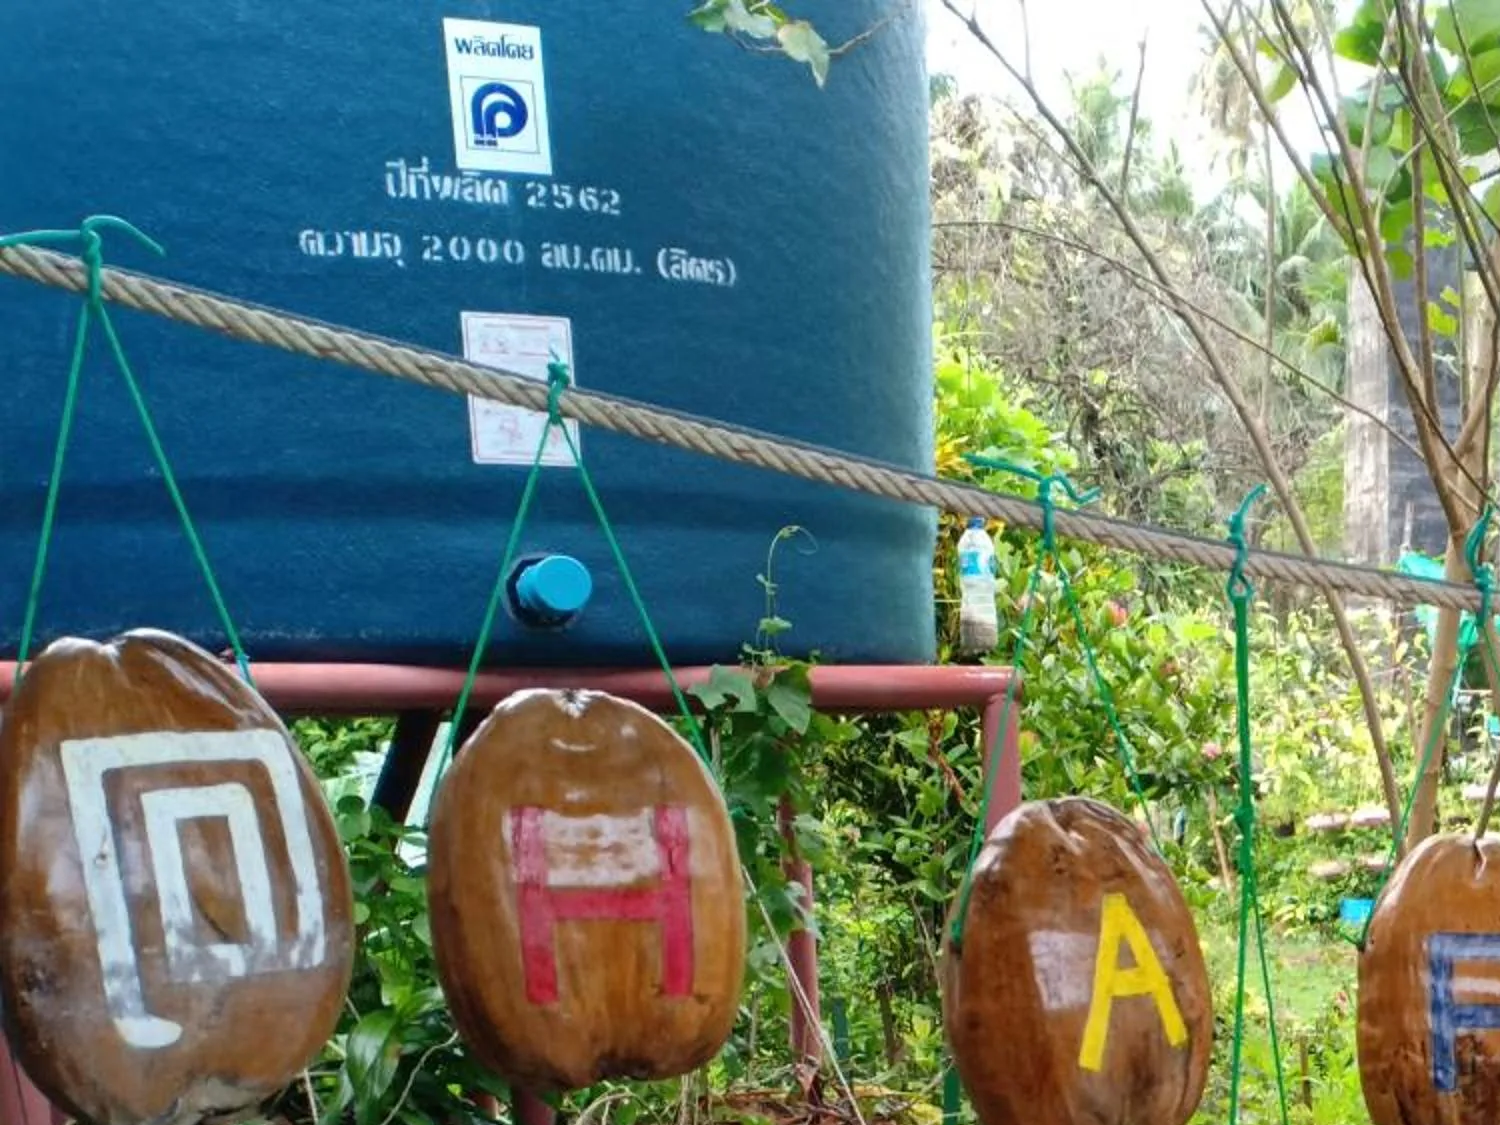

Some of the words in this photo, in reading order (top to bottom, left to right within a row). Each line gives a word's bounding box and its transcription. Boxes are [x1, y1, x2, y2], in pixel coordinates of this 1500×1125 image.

[525, 181, 621, 215] 2562
[421, 234, 525, 264] 2000
[510, 805, 695, 1005] H
[1079, 892, 1190, 1072] A
